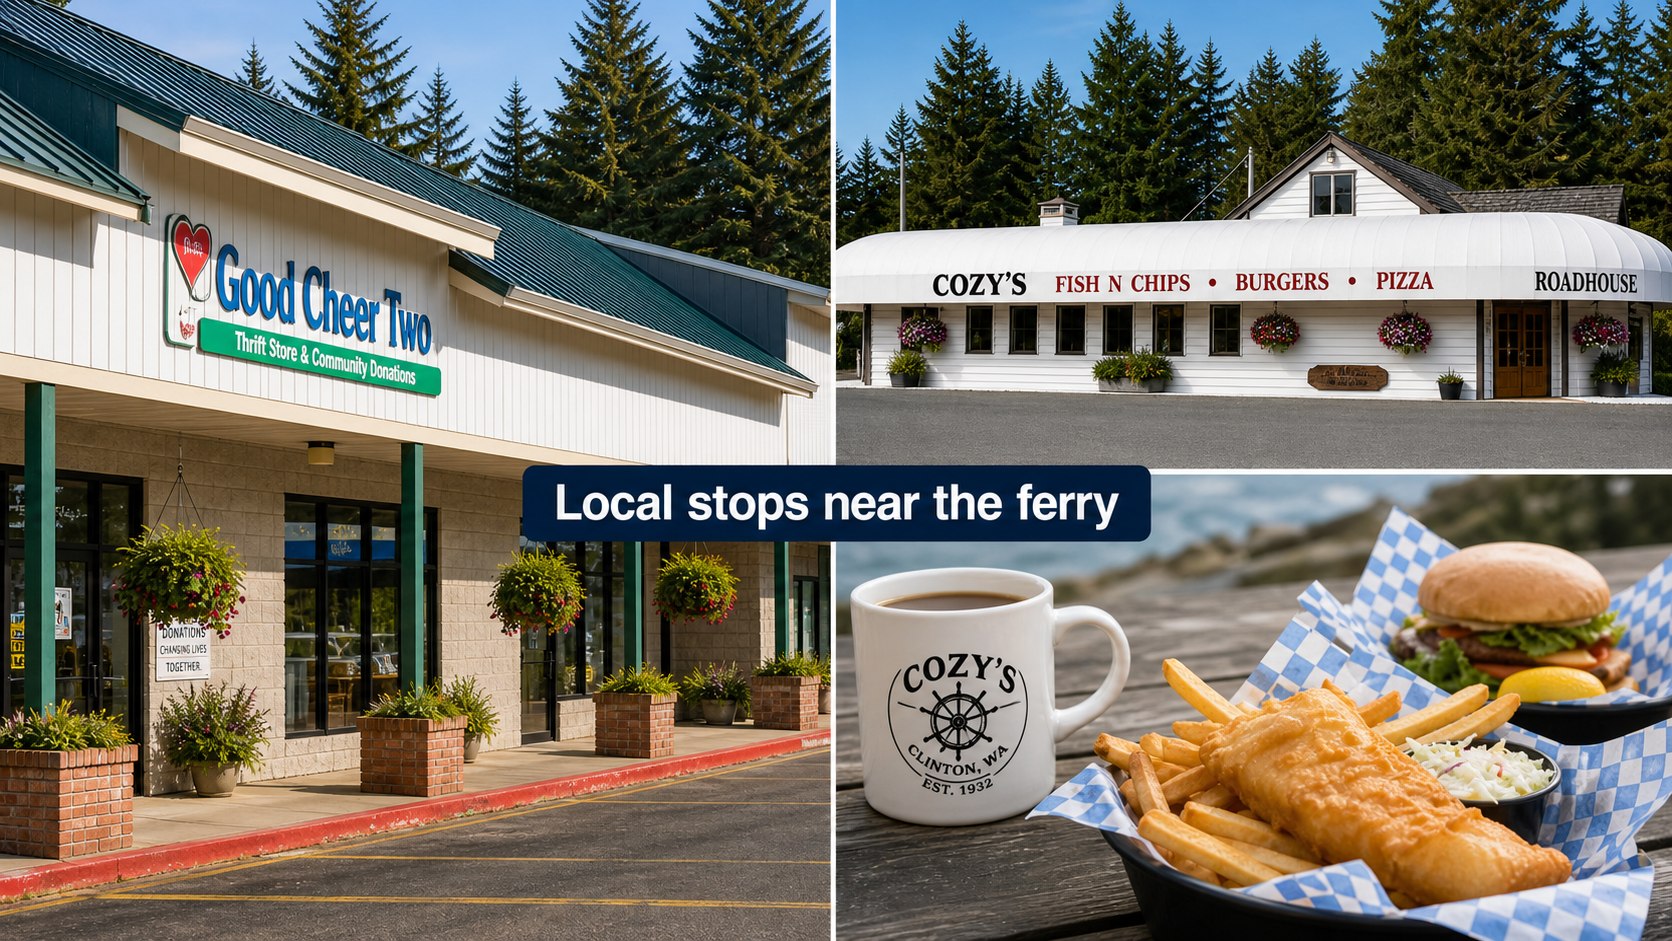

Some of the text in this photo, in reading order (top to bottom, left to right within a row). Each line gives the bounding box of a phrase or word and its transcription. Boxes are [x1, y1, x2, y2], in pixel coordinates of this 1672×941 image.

[932, 271, 1027, 296] COZY'S
[1055, 271, 1435, 293] FISH N CHIPS BURGERS PIZZA
[1535, 271, 1638, 293] ROADHOUSE
[216, 243, 432, 355] Good Cheer Two
[234, 330, 417, 385] Thrift Store & Community Donations
[162, 627, 206, 639] DONATIONS
[903, 653, 1017, 694] COZY'S
[907, 744, 1009, 776] CLINTON, WA
[922, 778, 993, 796] EST. 1932
